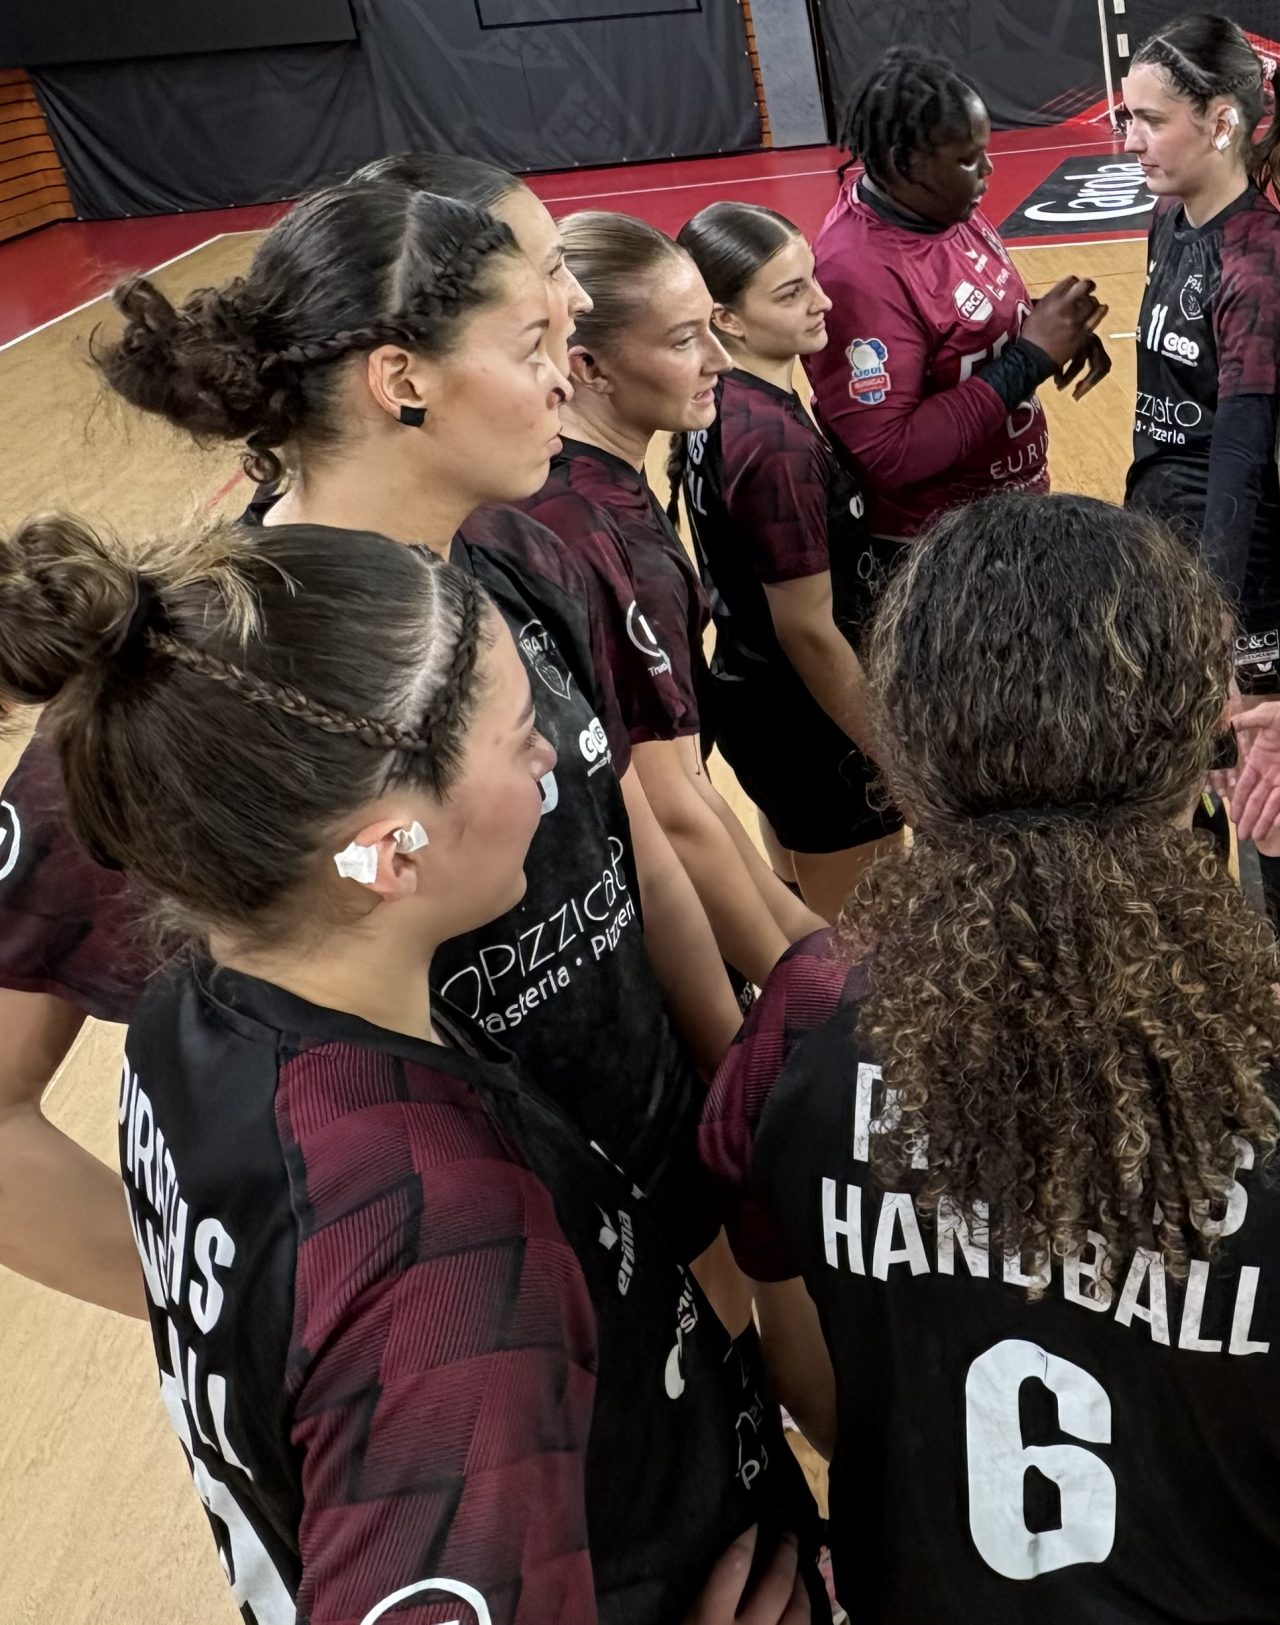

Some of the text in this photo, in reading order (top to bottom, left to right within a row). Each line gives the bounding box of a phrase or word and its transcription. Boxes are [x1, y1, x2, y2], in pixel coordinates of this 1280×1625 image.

[1024, 162, 1159, 222] Carola
[961, 287, 986, 319] reco
[479, 965, 571, 1034] asteria
[617, 1209, 635, 1297] erima
[965, 1338, 1117, 1581] 6
